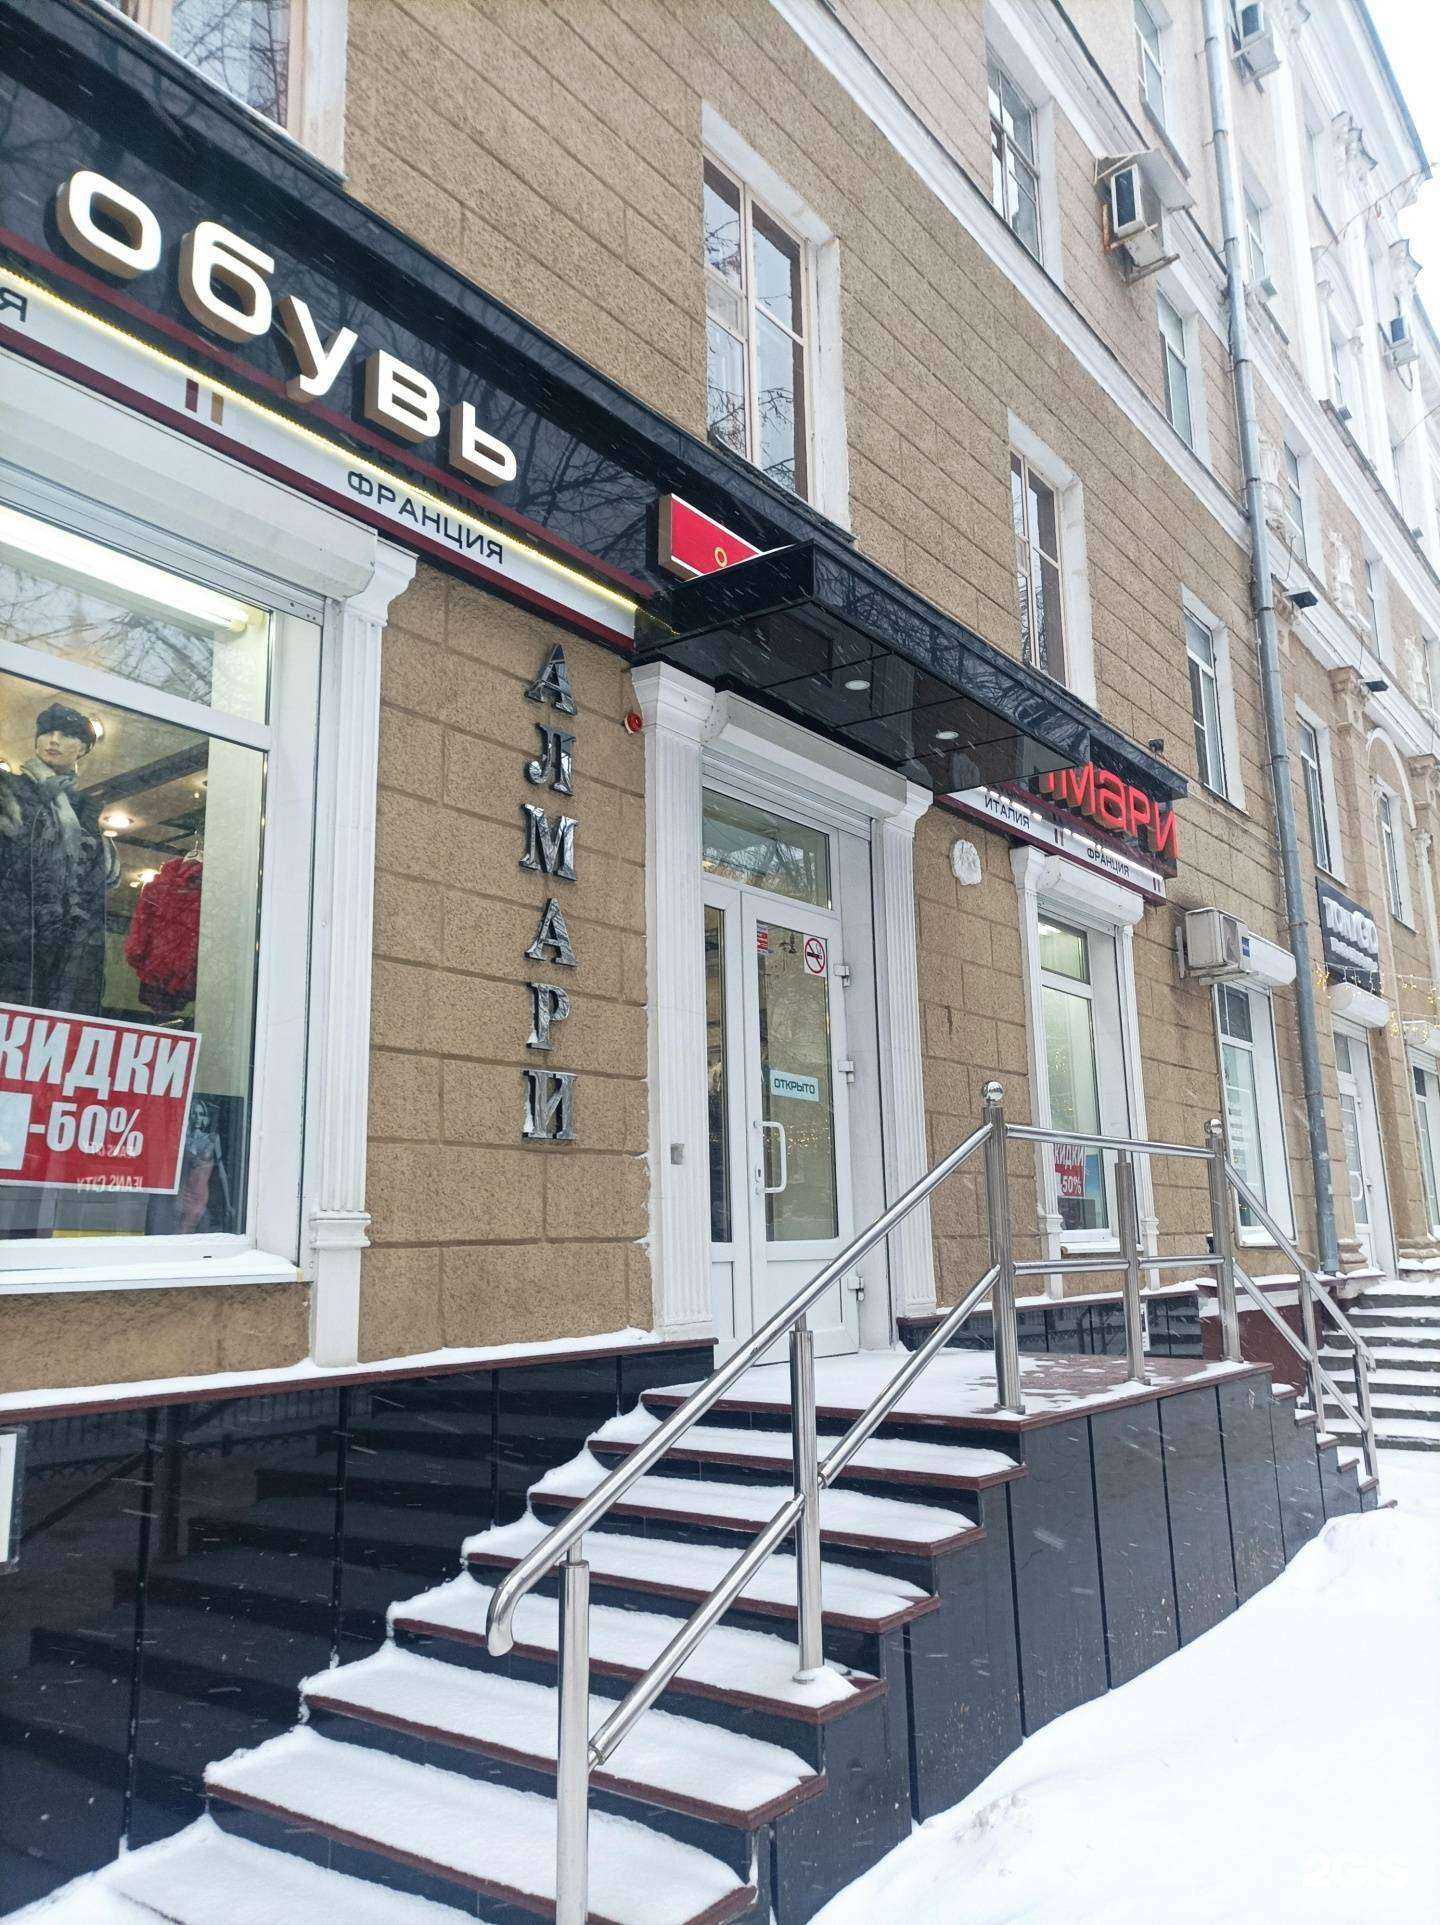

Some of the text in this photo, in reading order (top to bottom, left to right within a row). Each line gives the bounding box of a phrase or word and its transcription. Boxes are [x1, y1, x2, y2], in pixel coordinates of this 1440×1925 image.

[347, 470, 503, 564] ФРАНЦИЯ
[984, 794, 1030, 829] ИТАЛИЯ
[1086, 847, 1130, 878] ФРАНЦИЯ
[519, 643, 578, 1140] АЛМАРИ
[774, 1078, 816, 1095] ОТКРЫТО
